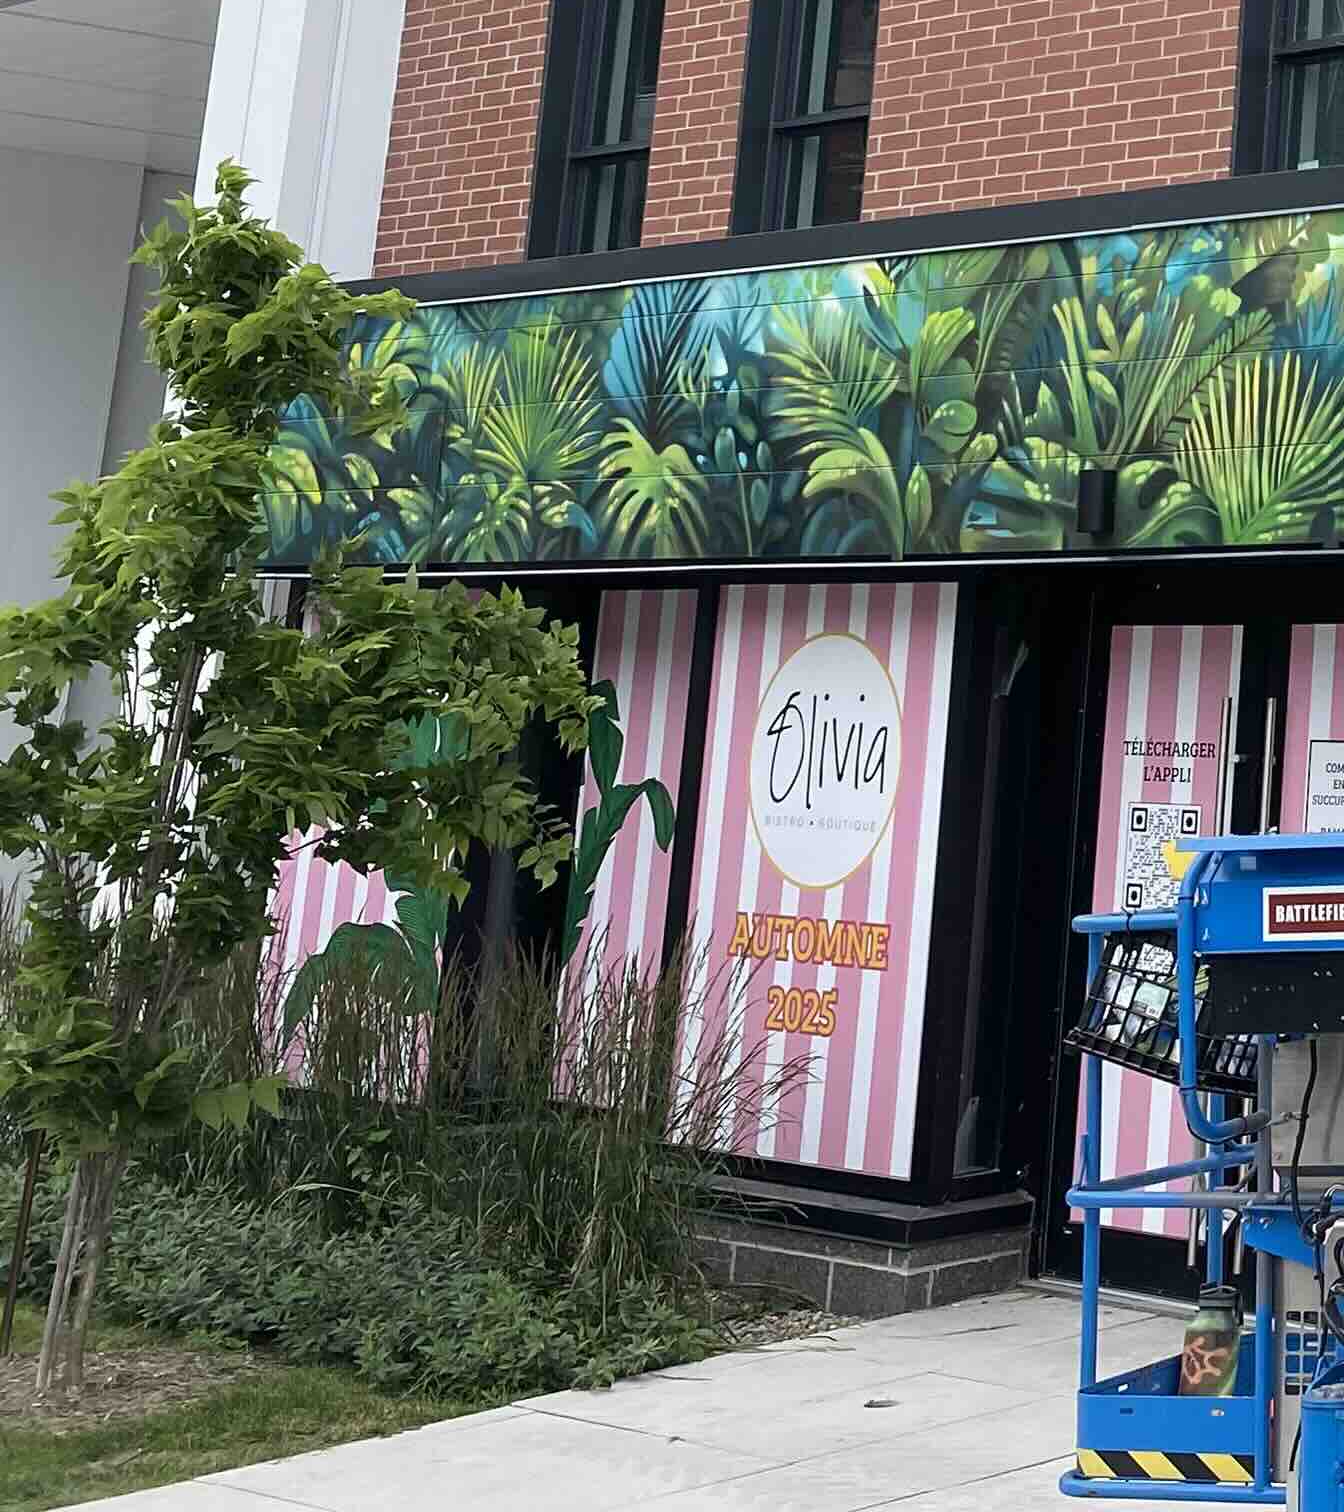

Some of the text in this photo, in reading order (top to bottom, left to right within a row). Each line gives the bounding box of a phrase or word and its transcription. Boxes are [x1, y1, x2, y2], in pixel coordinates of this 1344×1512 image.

[767, 691, 888, 810] Olivia
[1122, 736, 1217, 759] TÉLÉCHARGER
[1143, 765, 1192, 783] L'APPLI
[1333, 779, 1344, 790] EN
[727, 912, 891, 971] AUTOMNE
[765, 985, 839, 1037] 2025
